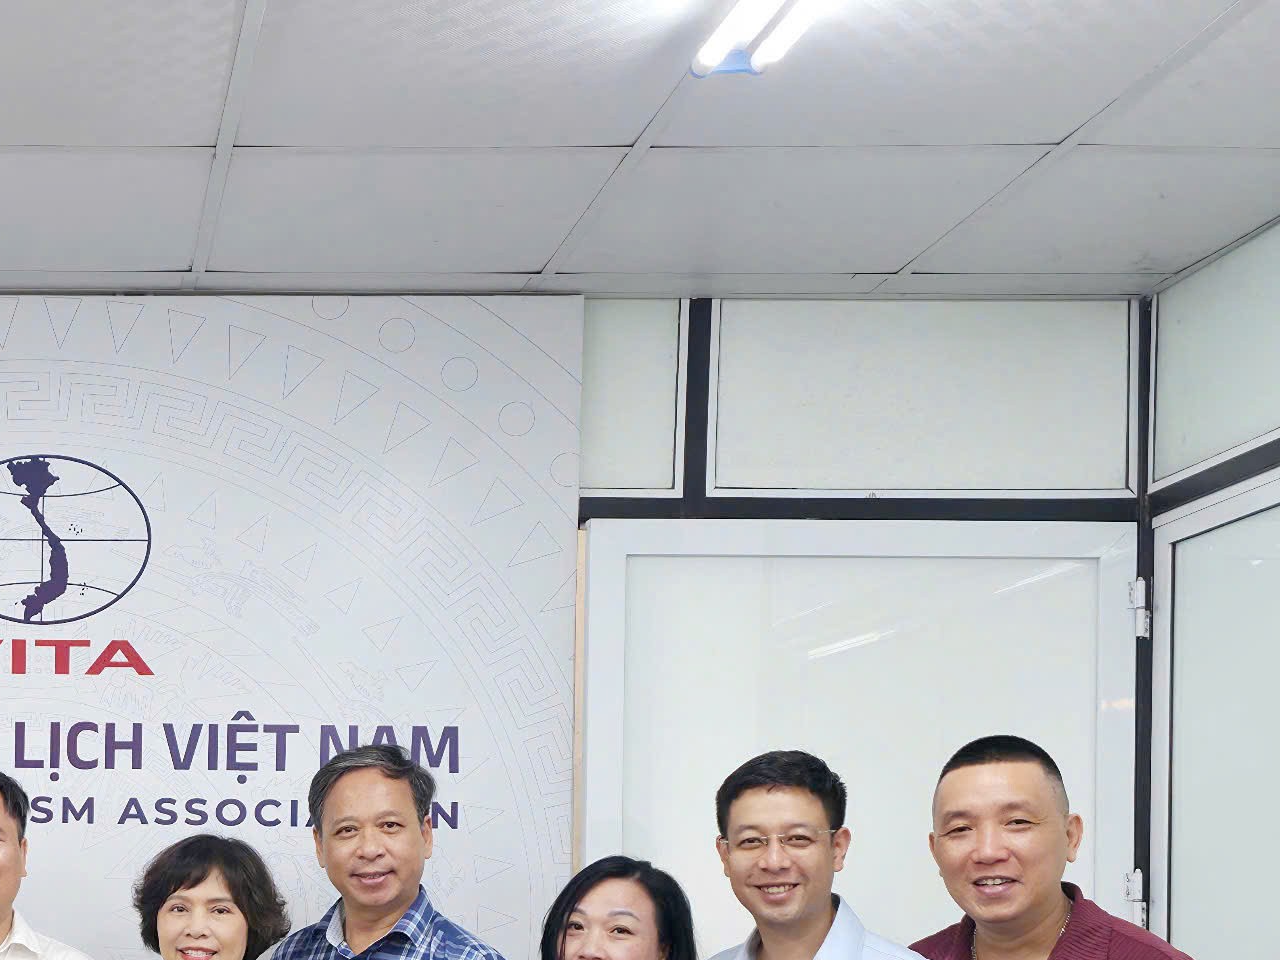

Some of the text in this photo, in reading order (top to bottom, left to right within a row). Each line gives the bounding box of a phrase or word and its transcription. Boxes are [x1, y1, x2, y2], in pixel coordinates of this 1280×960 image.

[14, 721, 144, 782] LỊCH
[163, 710, 300, 784] VIỆT
[117, 796, 459, 830] ASSOCIN
